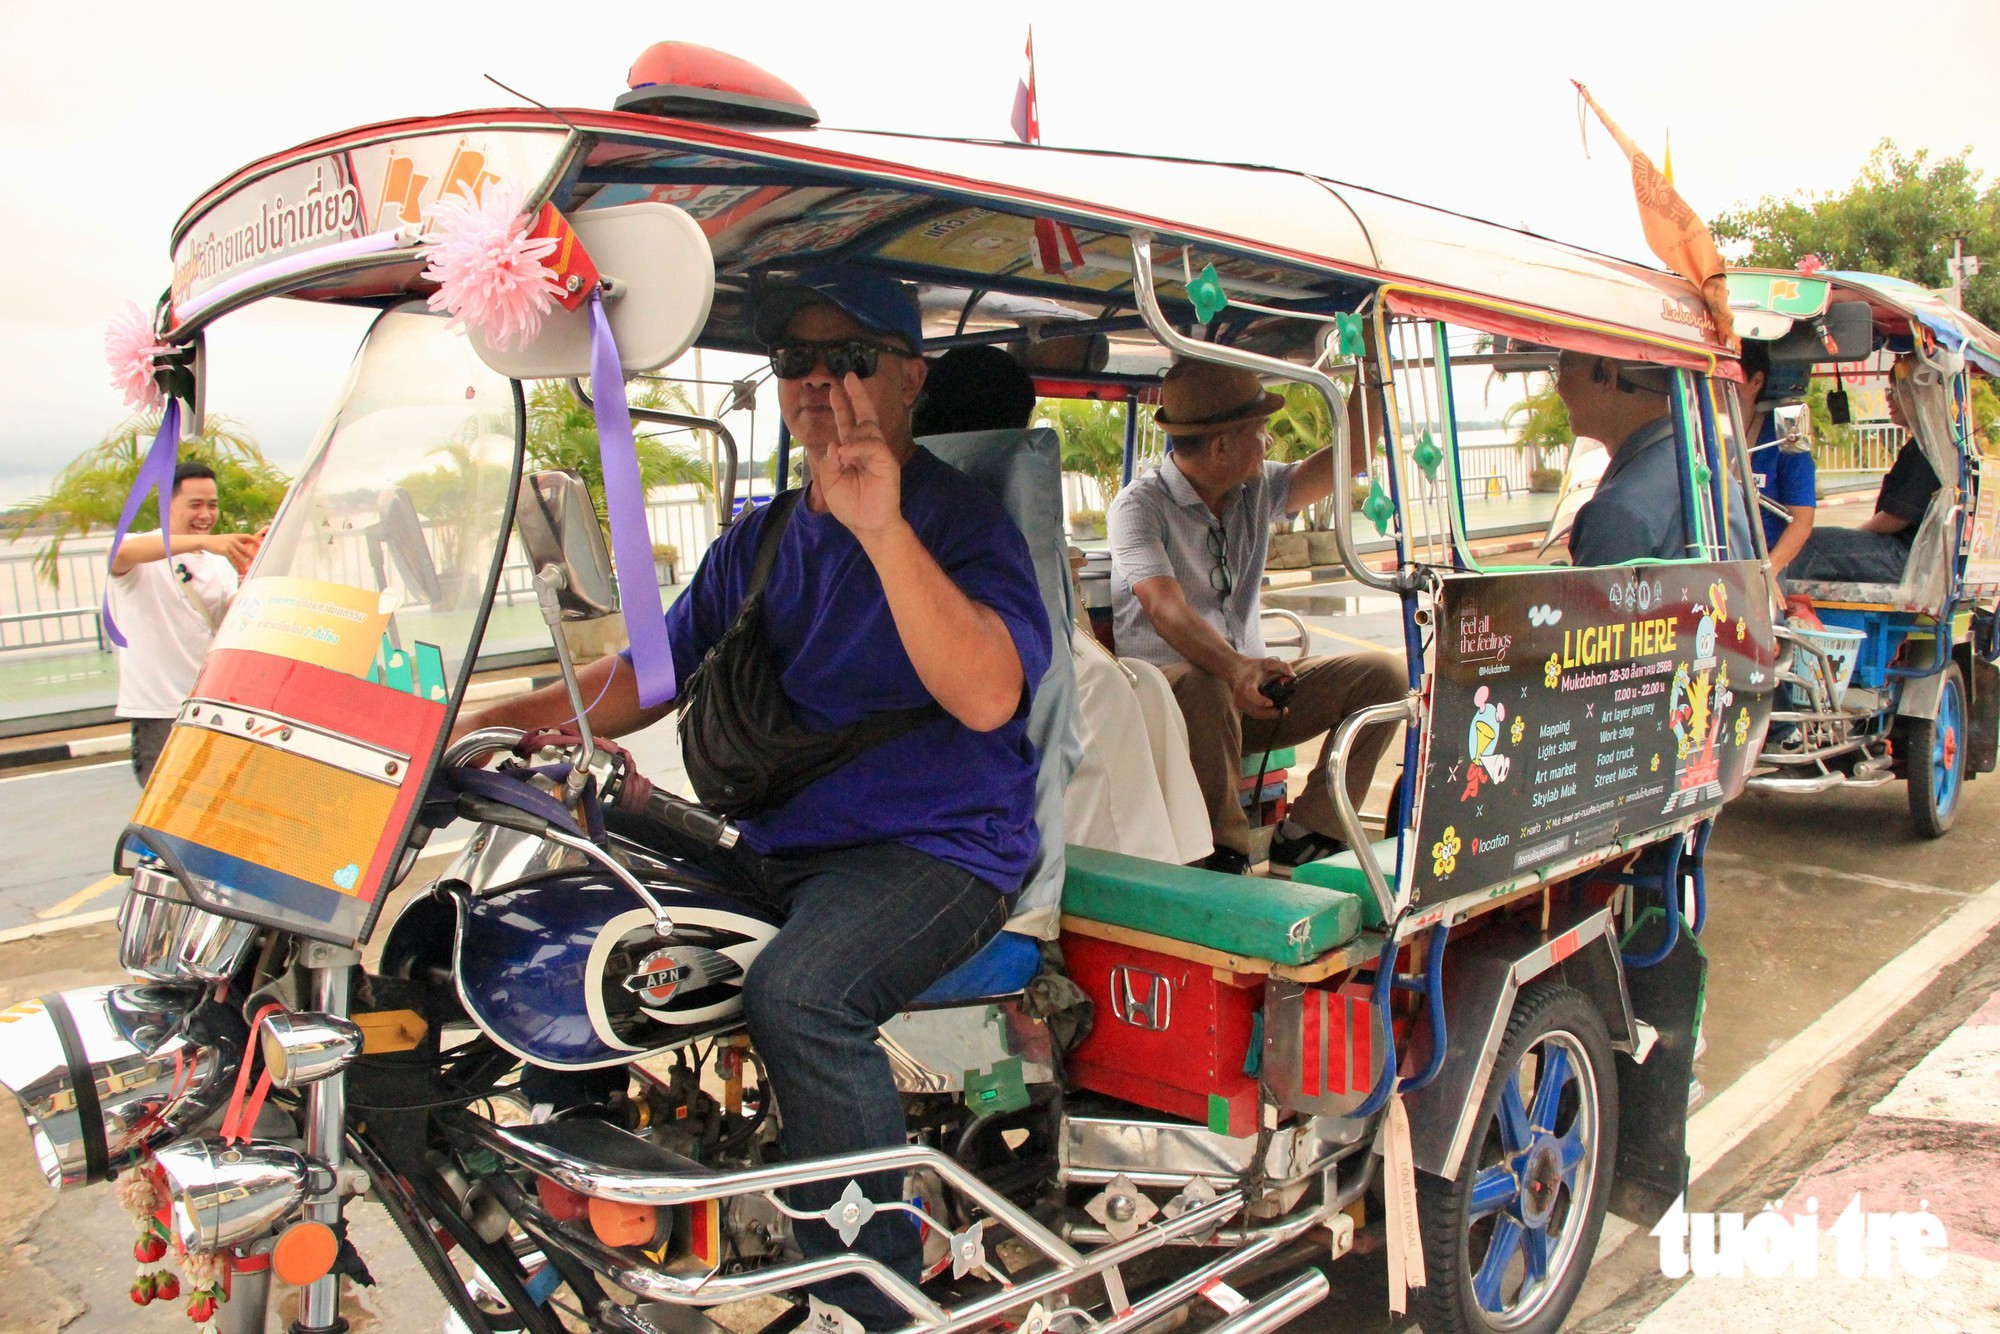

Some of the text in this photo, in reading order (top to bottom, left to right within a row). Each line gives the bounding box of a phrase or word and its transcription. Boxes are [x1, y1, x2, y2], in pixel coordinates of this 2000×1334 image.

[1461, 614, 1490, 636] feel all
[1460, 632, 1512, 661] the feelings
[1563, 616, 1678, 669] LIGHT HERE
[1478, 664, 1511, 676] @Mukdahan
[1561, 670, 1608, 693] Mukdahan
[1609, 668, 1630, 683] 28-30
[1614, 688, 1631, 702] 17.00
[1641, 681, 1659, 697] 22.00
[1601, 702, 1655, 724] Art layer journey
[1539, 719, 1571, 739] Mapping
[1600, 725, 1635, 744] Work shop
[1538, 738, 1577, 761] Light show
[1597, 745, 1635, 767] Food truck
[1534, 762, 1577, 785] Art market
[1594, 764, 1639, 788] Street Music
[1532, 782, 1577, 808] Skylab Muk
[1478, 833, 1510, 853] location
[646, 967, 681, 988] APN
[1400, 1161, 1416, 1250] LOVE IS ETERNAL
